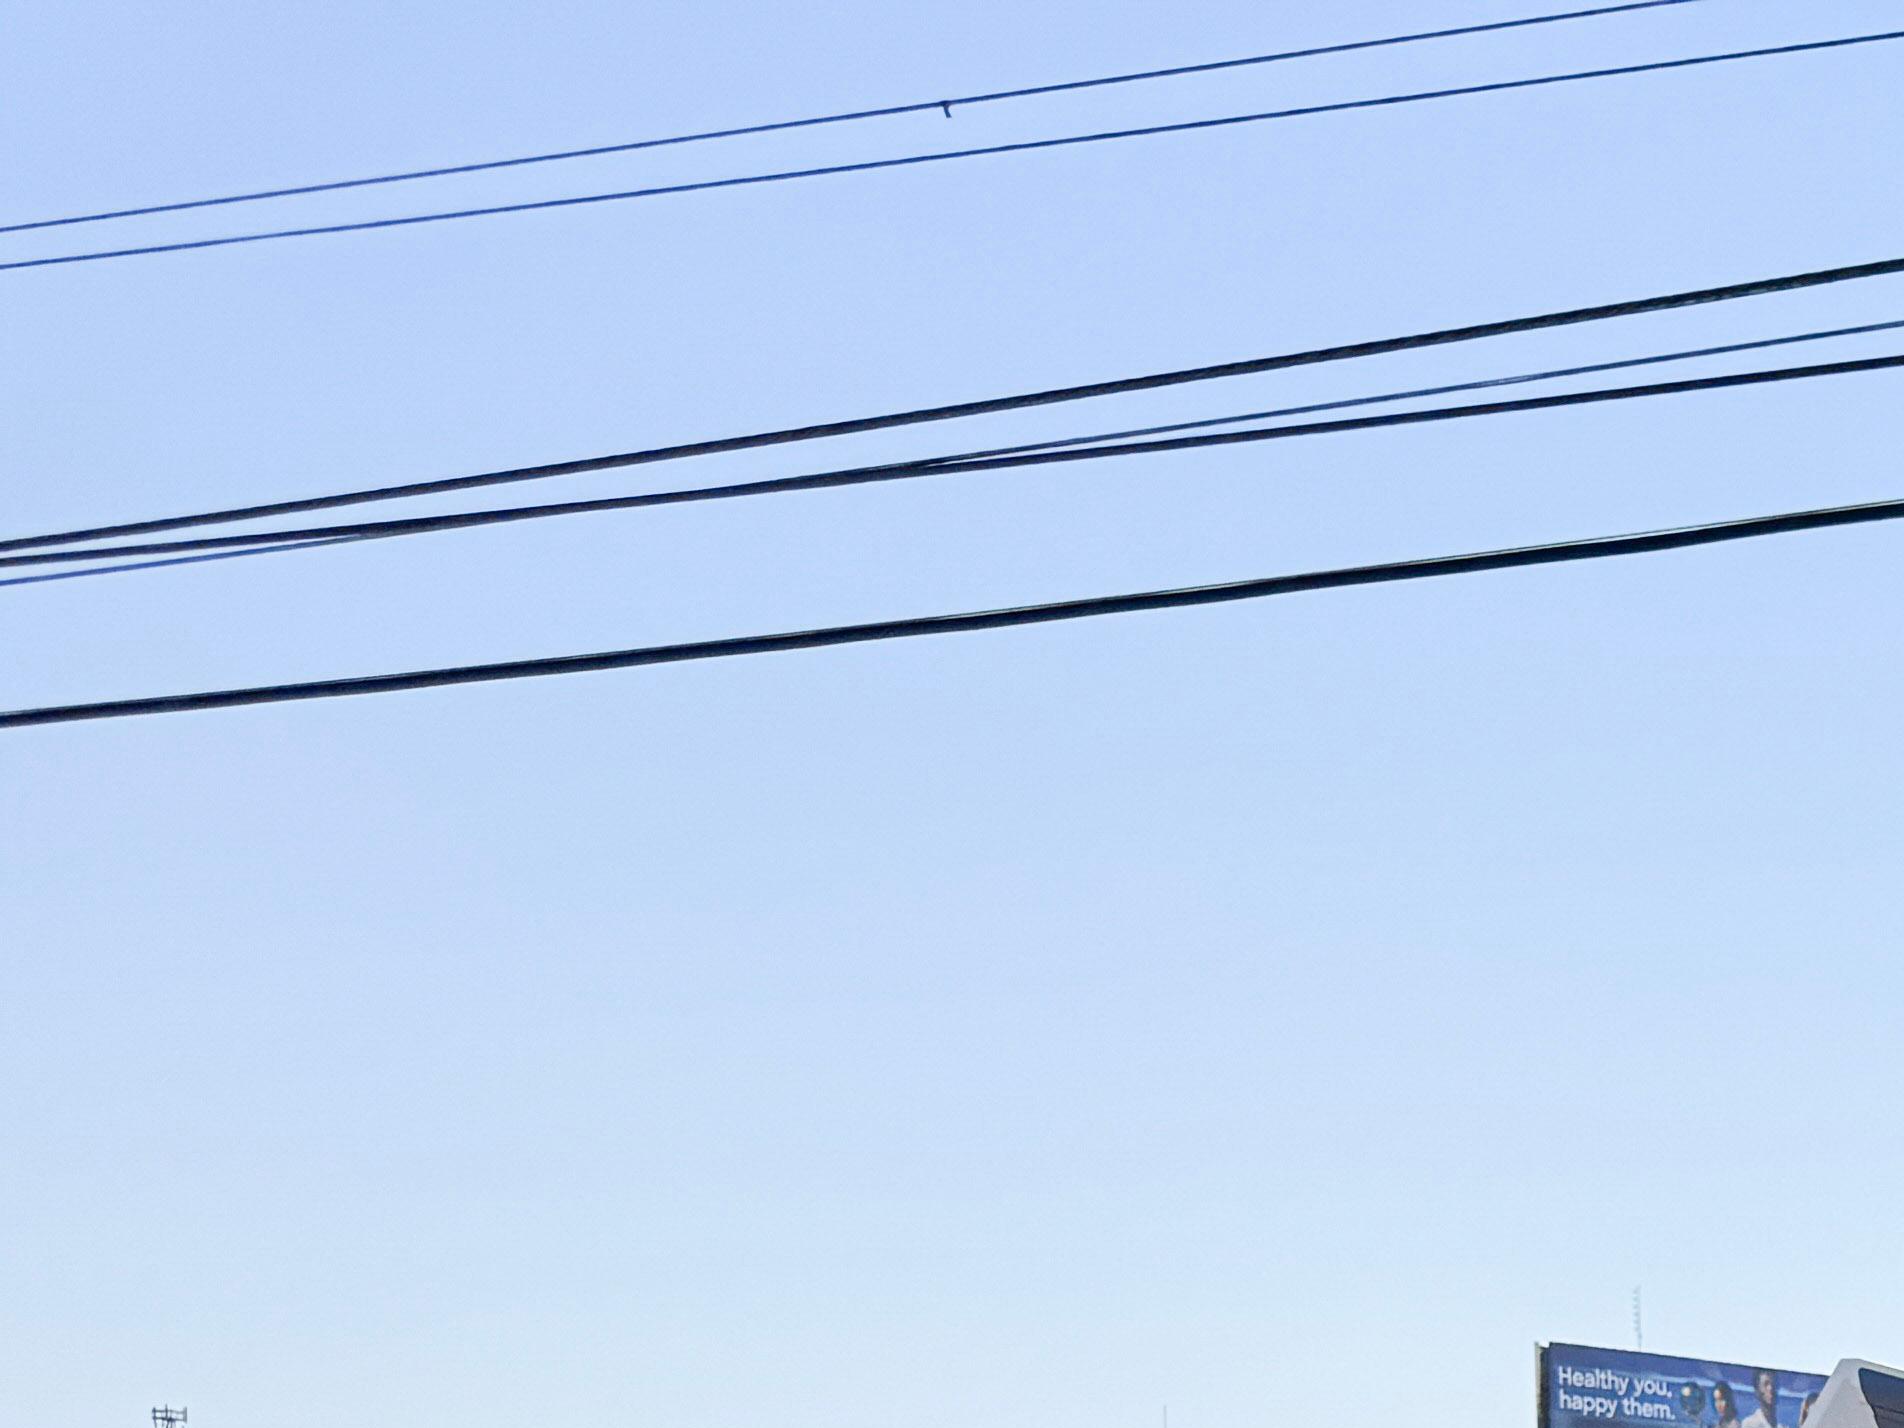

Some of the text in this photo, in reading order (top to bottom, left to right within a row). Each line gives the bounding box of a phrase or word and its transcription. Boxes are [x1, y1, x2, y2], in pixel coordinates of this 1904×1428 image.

[1558, 1365, 1629, 1396] Healthy
[1558, 1388, 1676, 1420] happy them.
